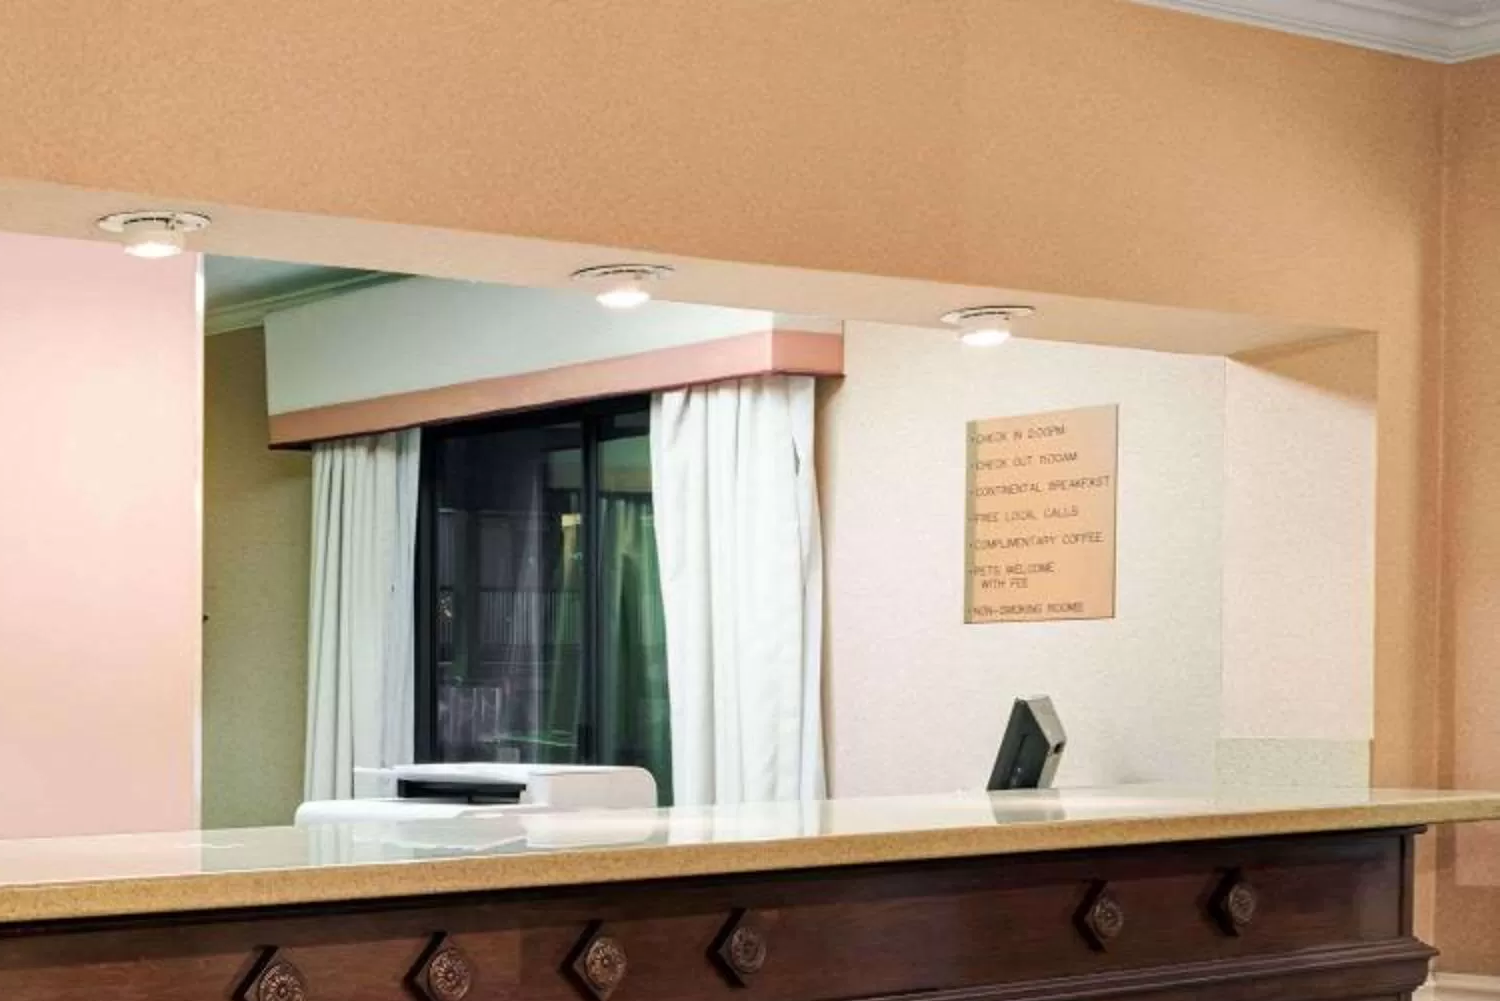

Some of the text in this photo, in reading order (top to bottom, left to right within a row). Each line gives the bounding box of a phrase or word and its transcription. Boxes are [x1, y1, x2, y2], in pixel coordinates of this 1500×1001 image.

[1013, 430, 1023, 441] IN
[1012, 455, 1033, 467] OUT
[975, 475, 1110, 497] CONTINENTAL BREAKFAST
[974, 504, 1079, 523] FREE LOCAL CALLS
[1061, 531, 1105, 545] COFFEE
[1006, 560, 1055, 575] WELCOME
[981, 578, 1007, 590] WITH
[973, 601, 1084, 617] NON-SMOKING ROOMS
